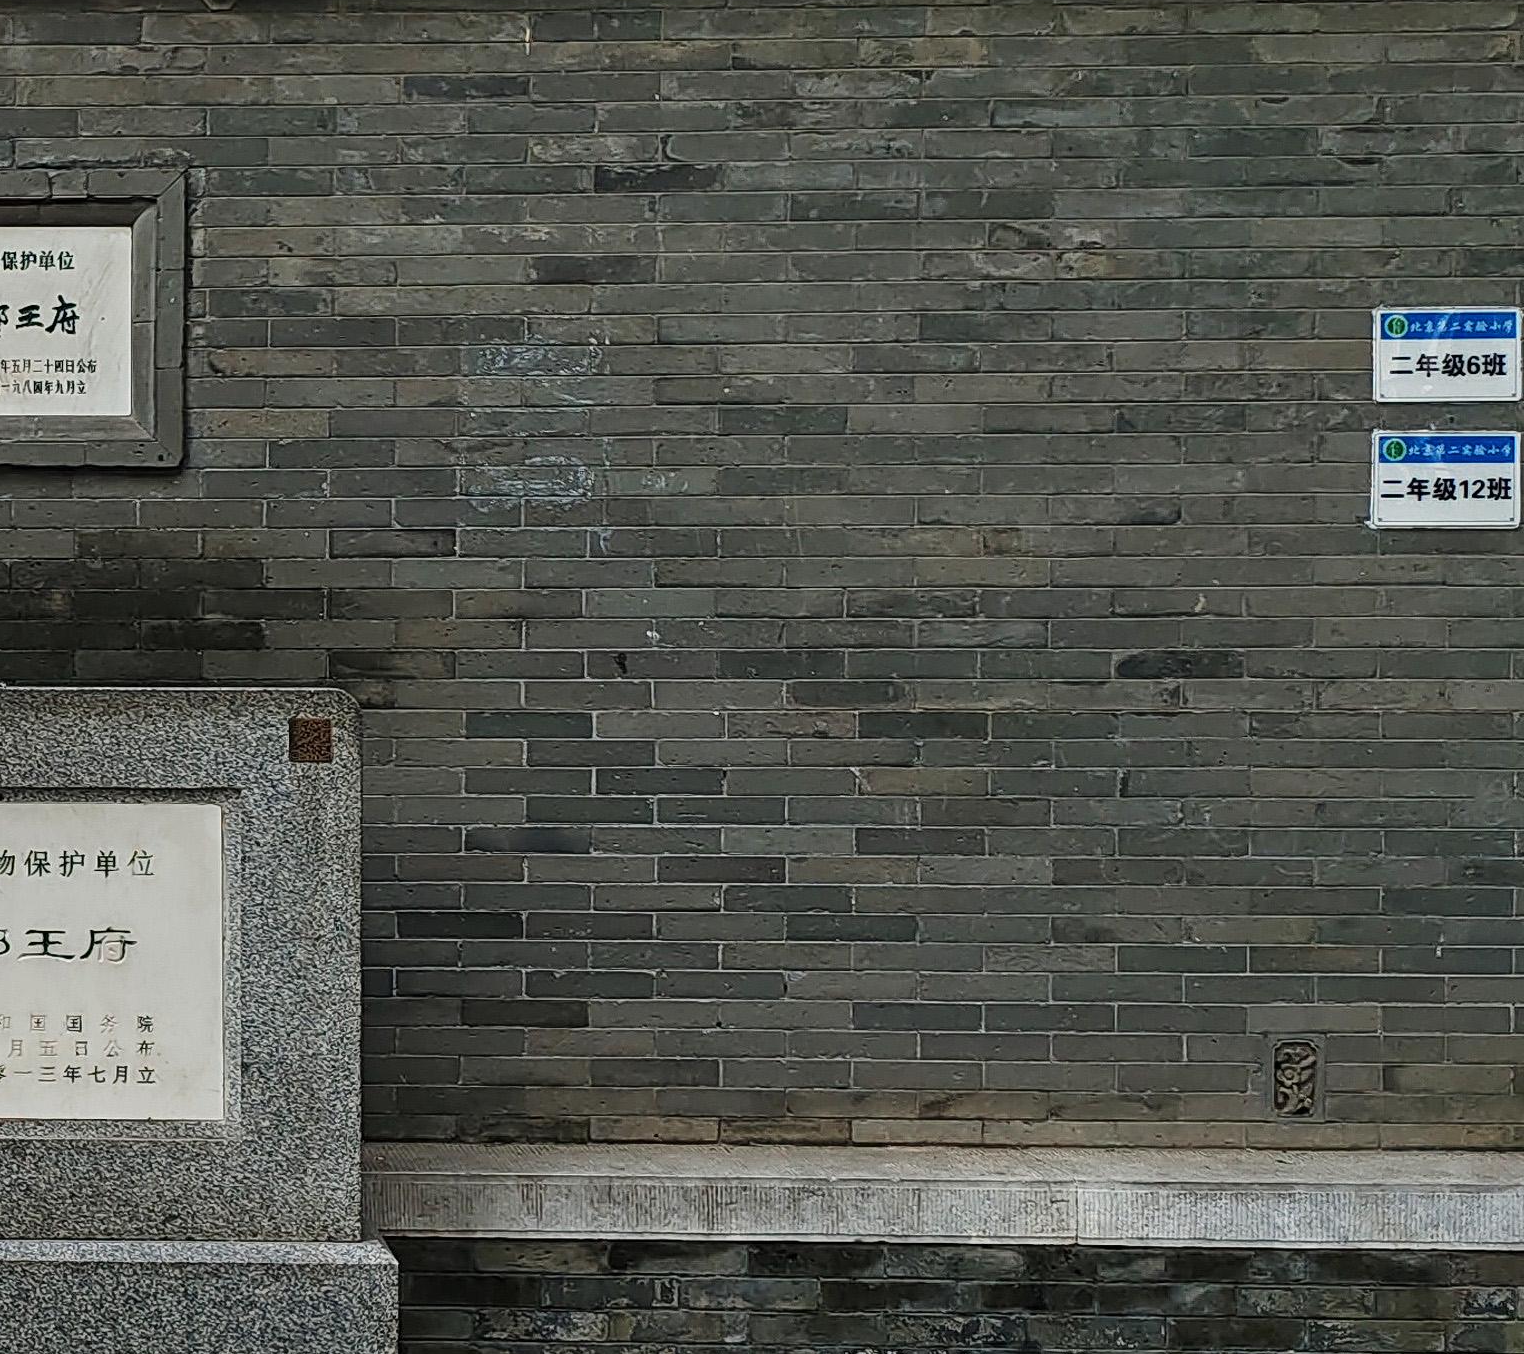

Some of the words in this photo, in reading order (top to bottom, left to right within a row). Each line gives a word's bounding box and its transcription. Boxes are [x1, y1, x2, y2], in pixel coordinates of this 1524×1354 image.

[1410, 317, 1514, 334] 北京第二实验小学
[1389, 352, 1507, 378] 二年级6班
[1408, 443, 1512, 459] 北京第二实验小学
[1380, 477, 1513, 502] 二年级12班
